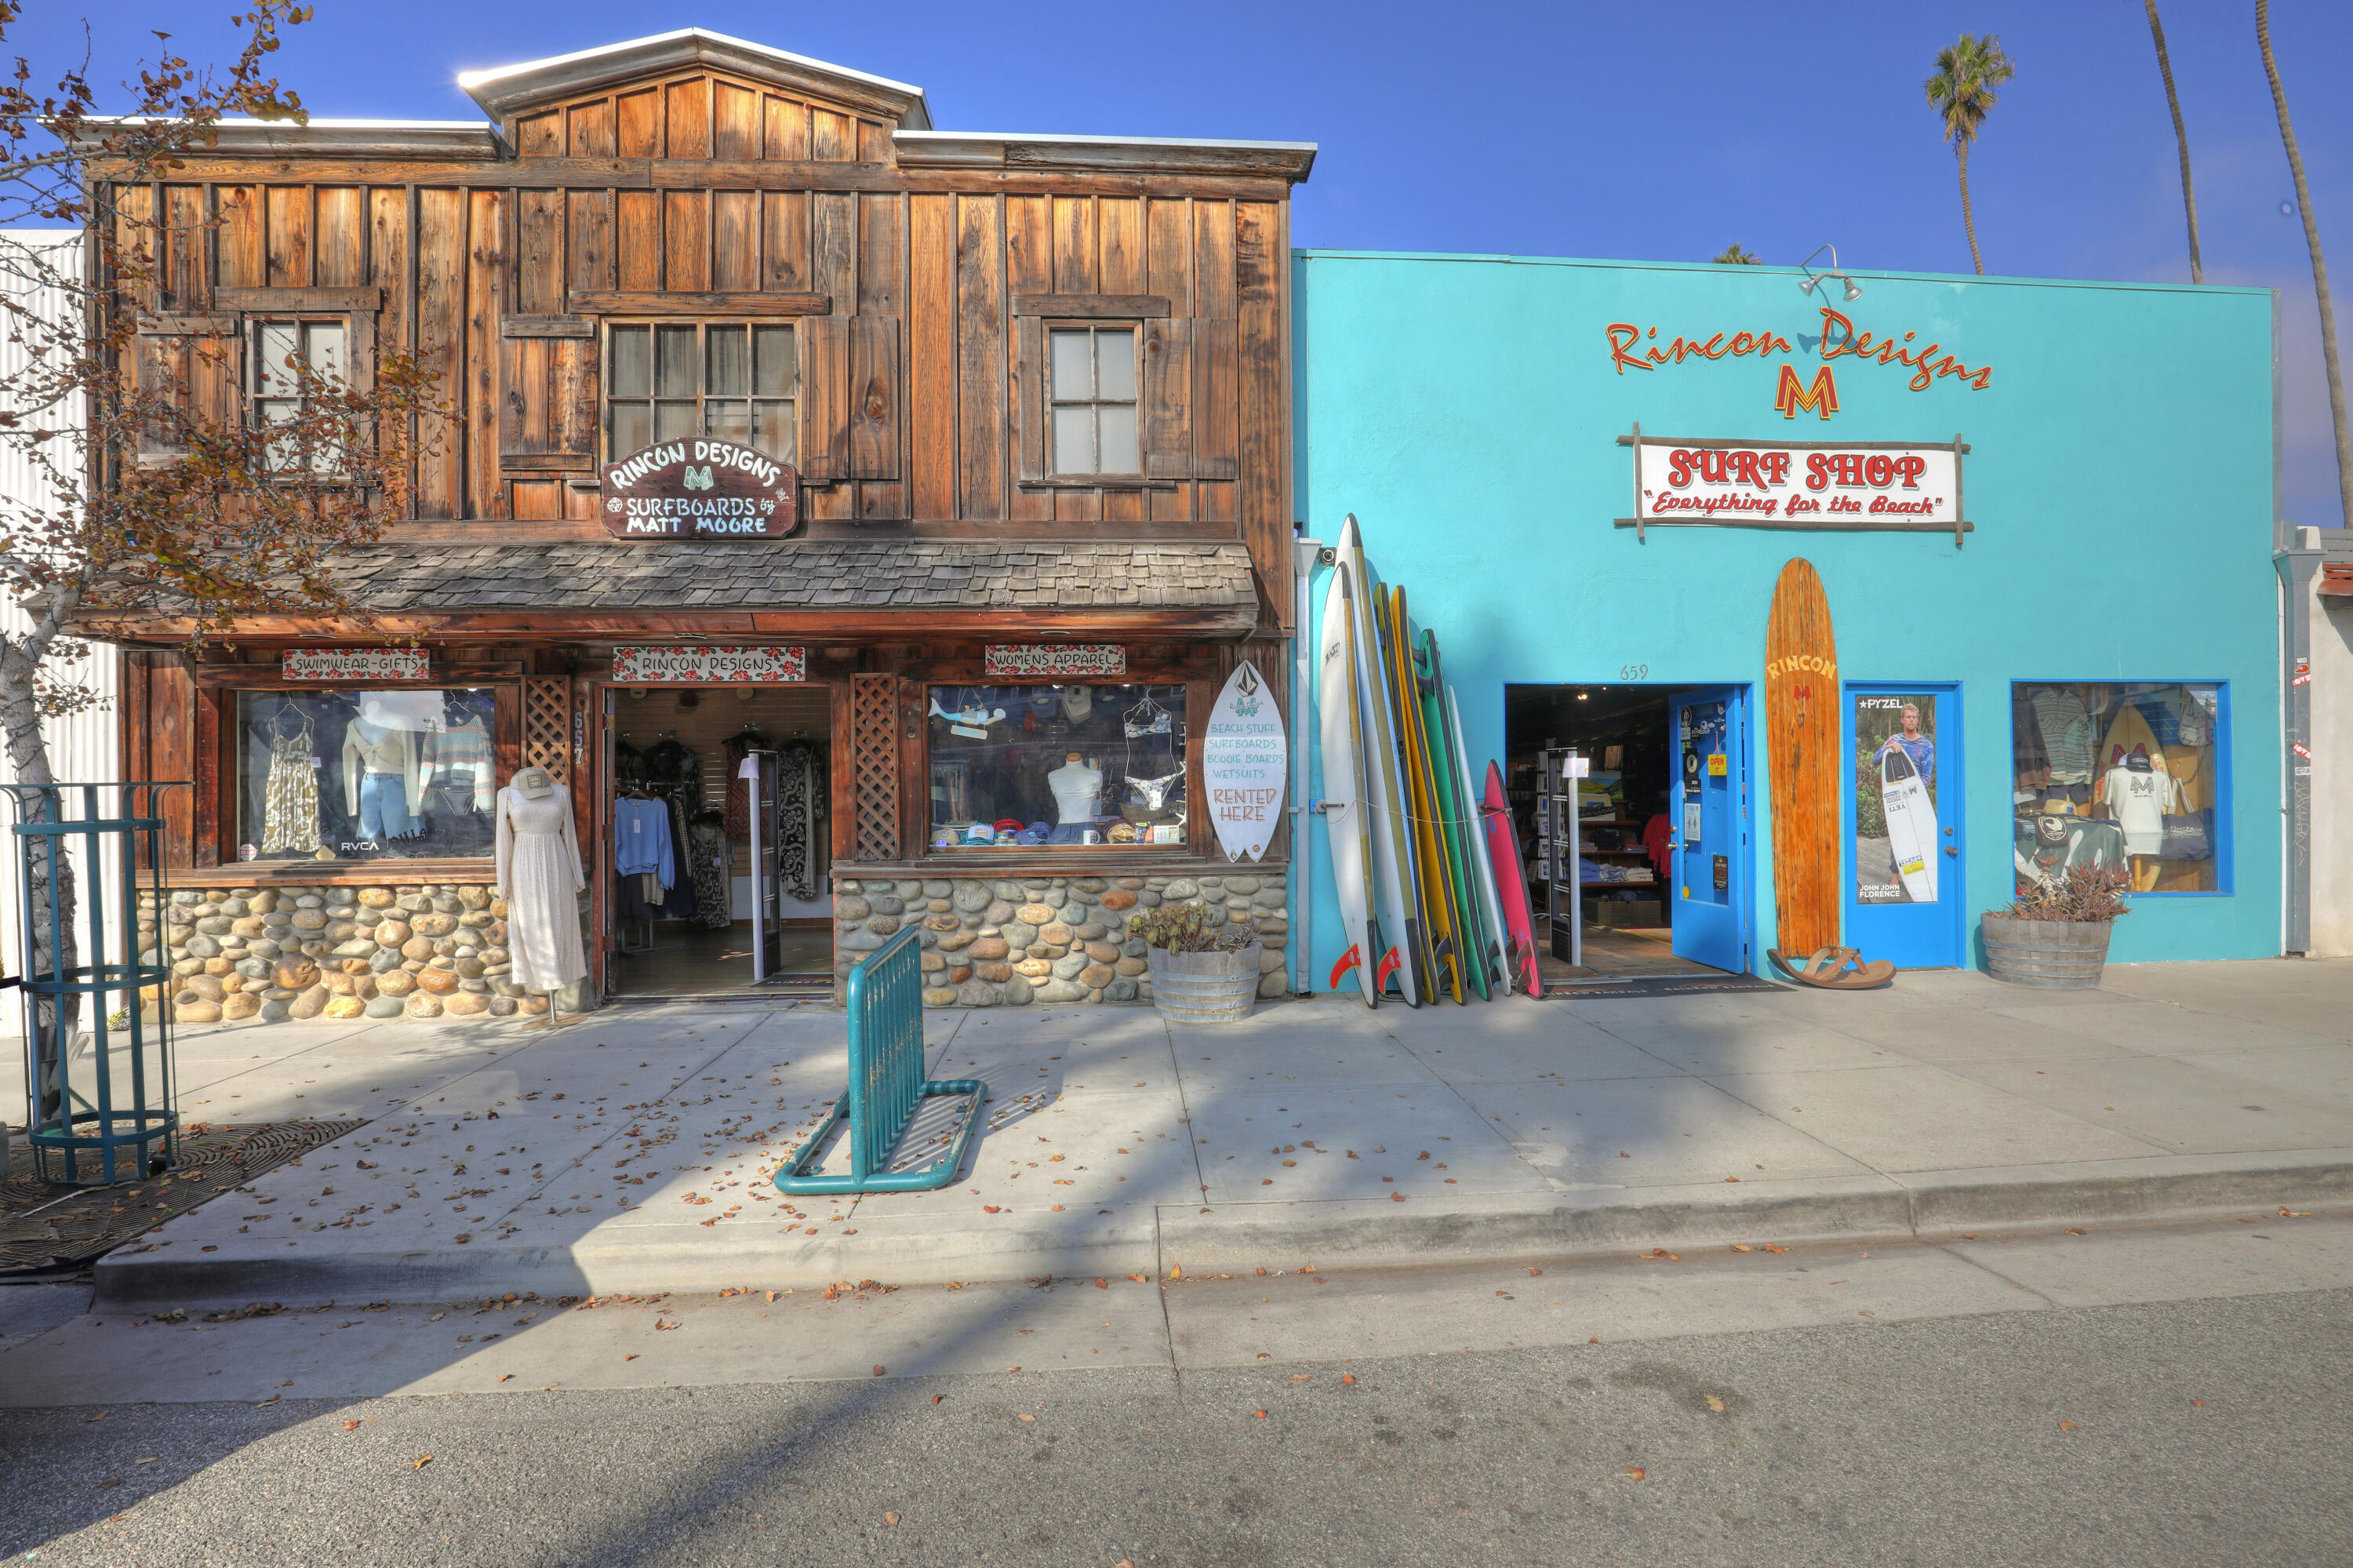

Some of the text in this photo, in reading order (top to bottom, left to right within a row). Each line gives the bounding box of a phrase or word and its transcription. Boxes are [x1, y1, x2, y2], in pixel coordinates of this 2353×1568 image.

[1606, 307, 1992, 391] Rincon Designs
[609, 441, 781, 489] RINCON DESIGNS
[1667, 449, 1927, 492] SURF SHOP
[626, 497, 776, 516] SURFBOARDS by
[1785, 493, 1822, 515] for
[1827, 495, 1862, 514] the
[627, 517, 767, 533] MATT MOORE
[642, 657, 773, 671] RINCON DESIGNS
[995, 653, 1113, 666] WOMENS APPAREL
[1766, 654, 1838, 680] RINCON
[1620, 664, 1649, 681] 659
[1867, 698, 1904, 709] PYZEL
[1211, 724, 1277, 734] BEACH STUFF
[574, 711, 584, 765] 657
[1209, 740, 1276, 749] SURFBOARDS
[1207, 755, 1284, 764] BOOGIE BOARDS
[1213, 769, 1266, 779] WETSUITS
[1213, 788, 1278, 805] RENTED
[1220, 806, 1267, 822] HERE
[341, 842, 380, 851] RVCA
